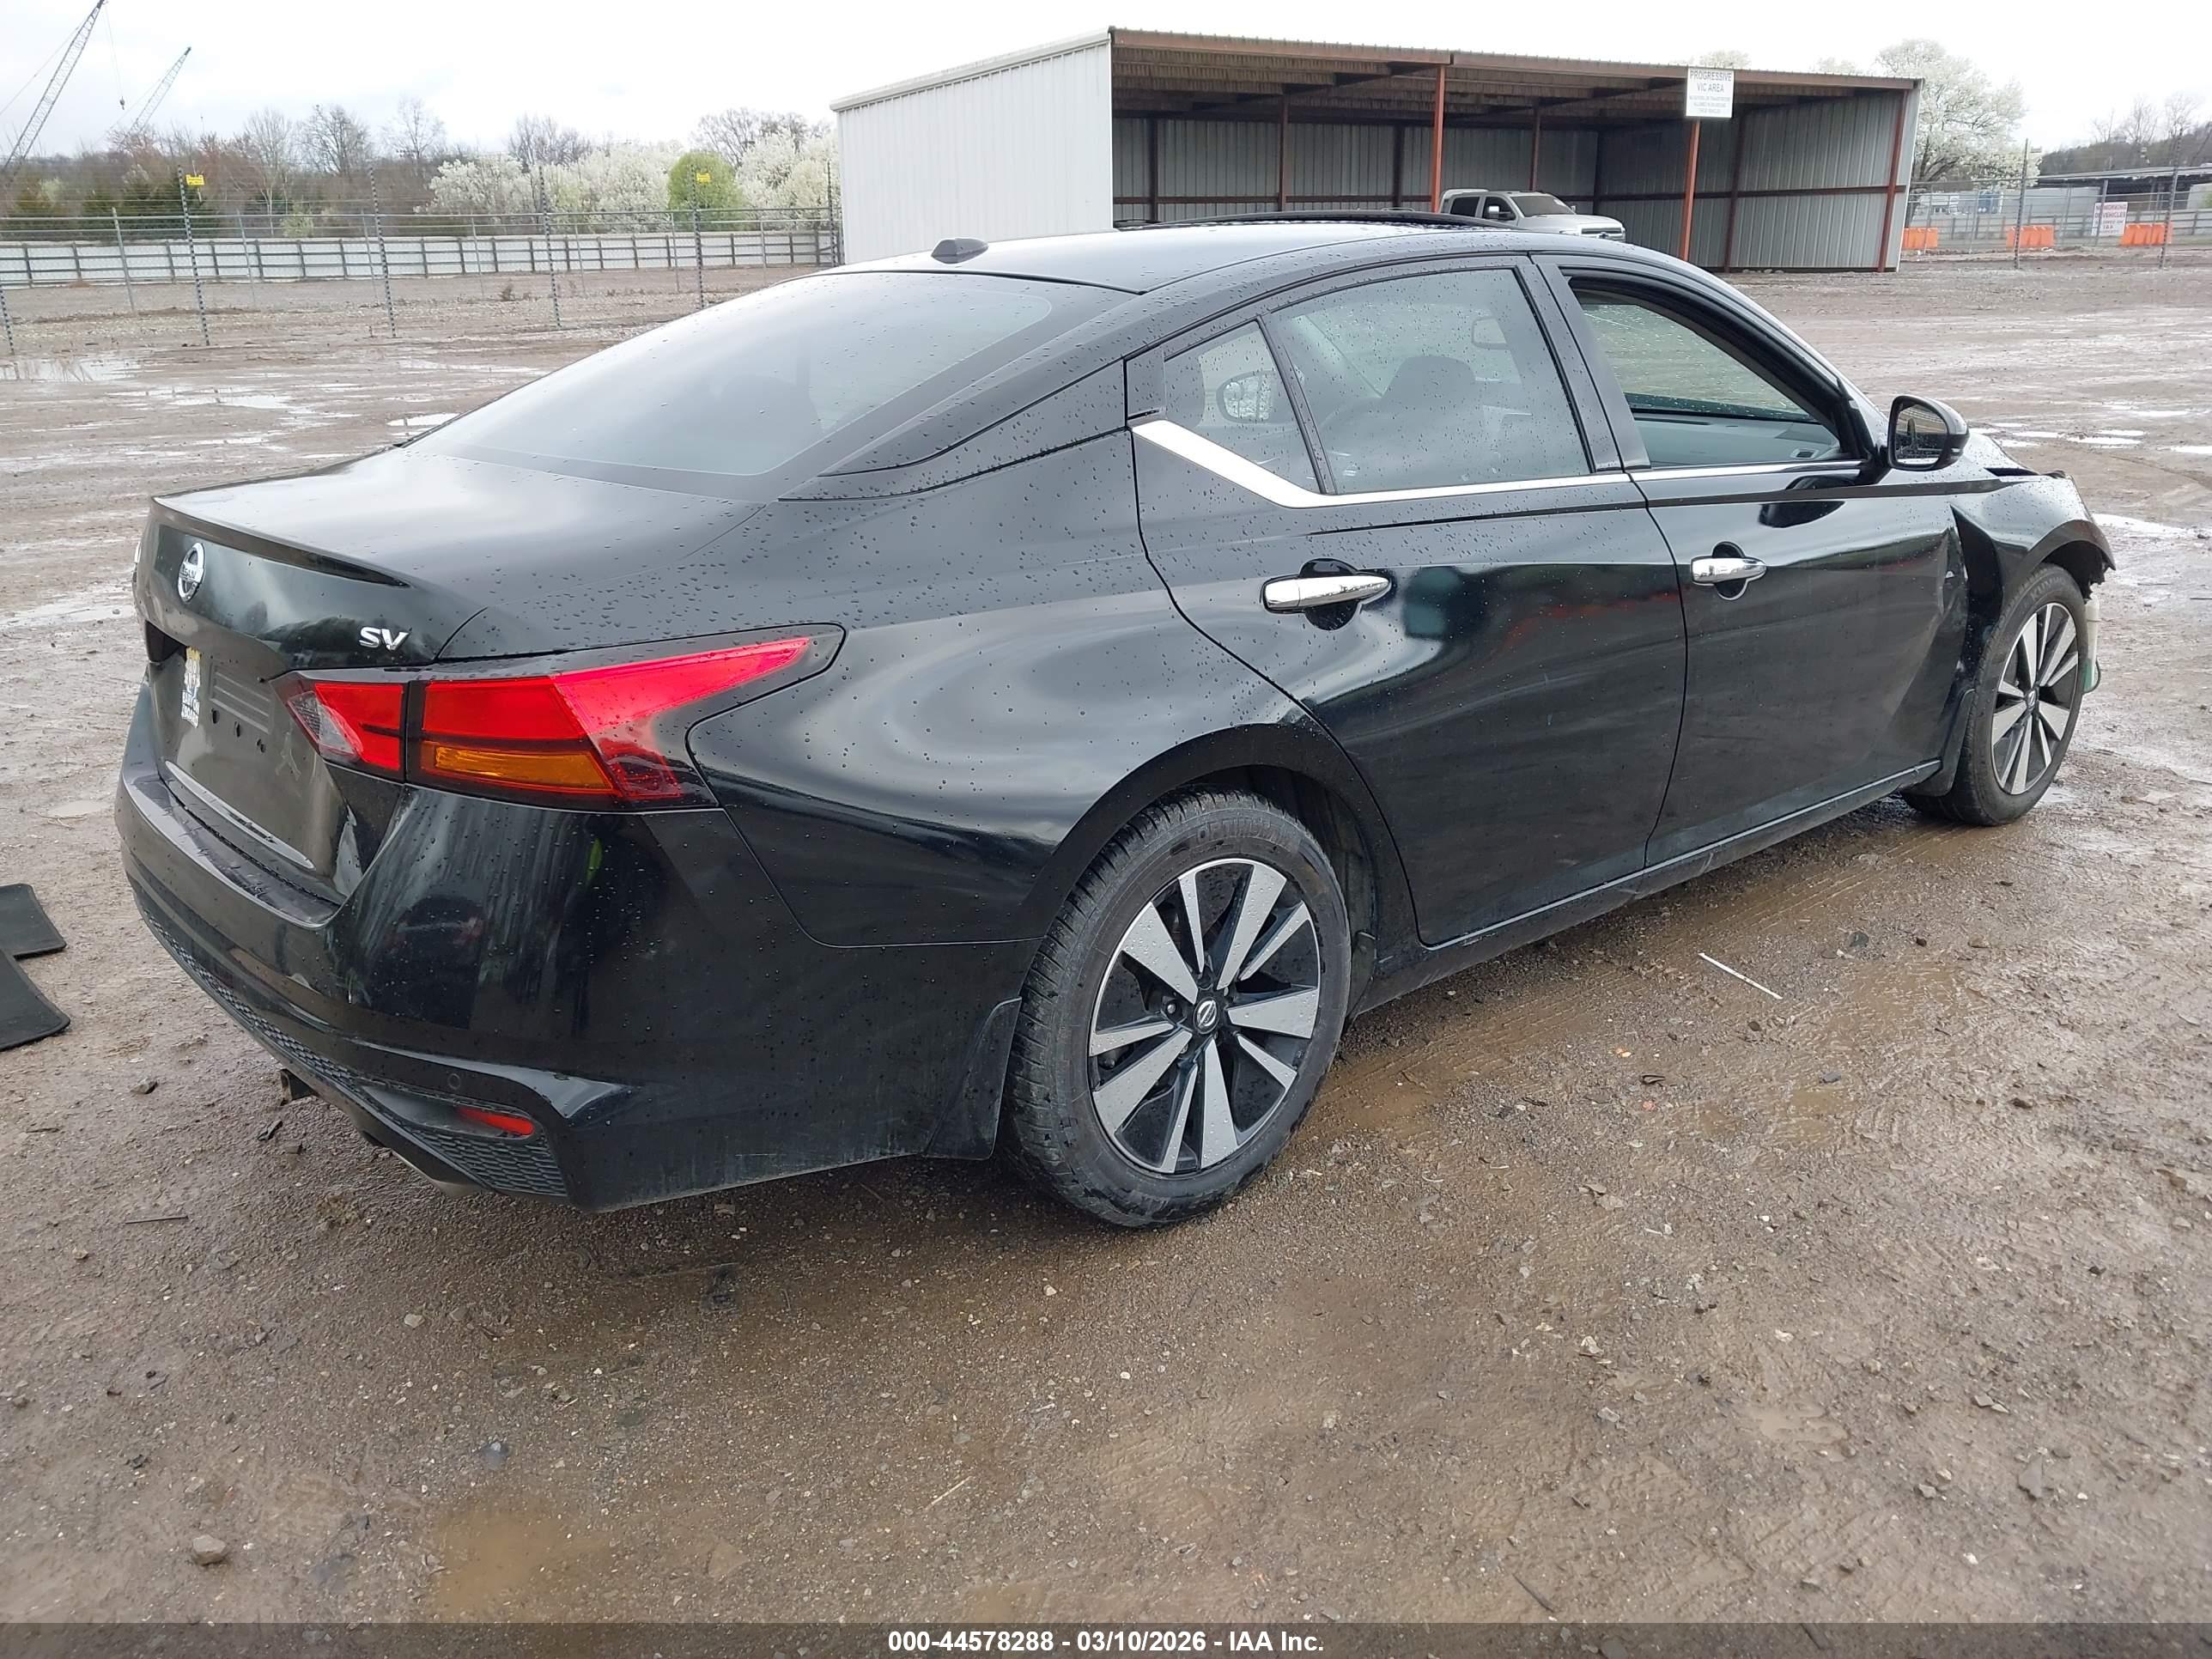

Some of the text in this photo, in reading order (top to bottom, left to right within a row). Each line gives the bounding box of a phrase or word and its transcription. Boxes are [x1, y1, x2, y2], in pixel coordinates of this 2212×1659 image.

[1690, 70, 1732, 82] PROGRESSIVE
[1697, 82, 1724, 93] VIC AREA
[359, 627, 409, 650] SV
